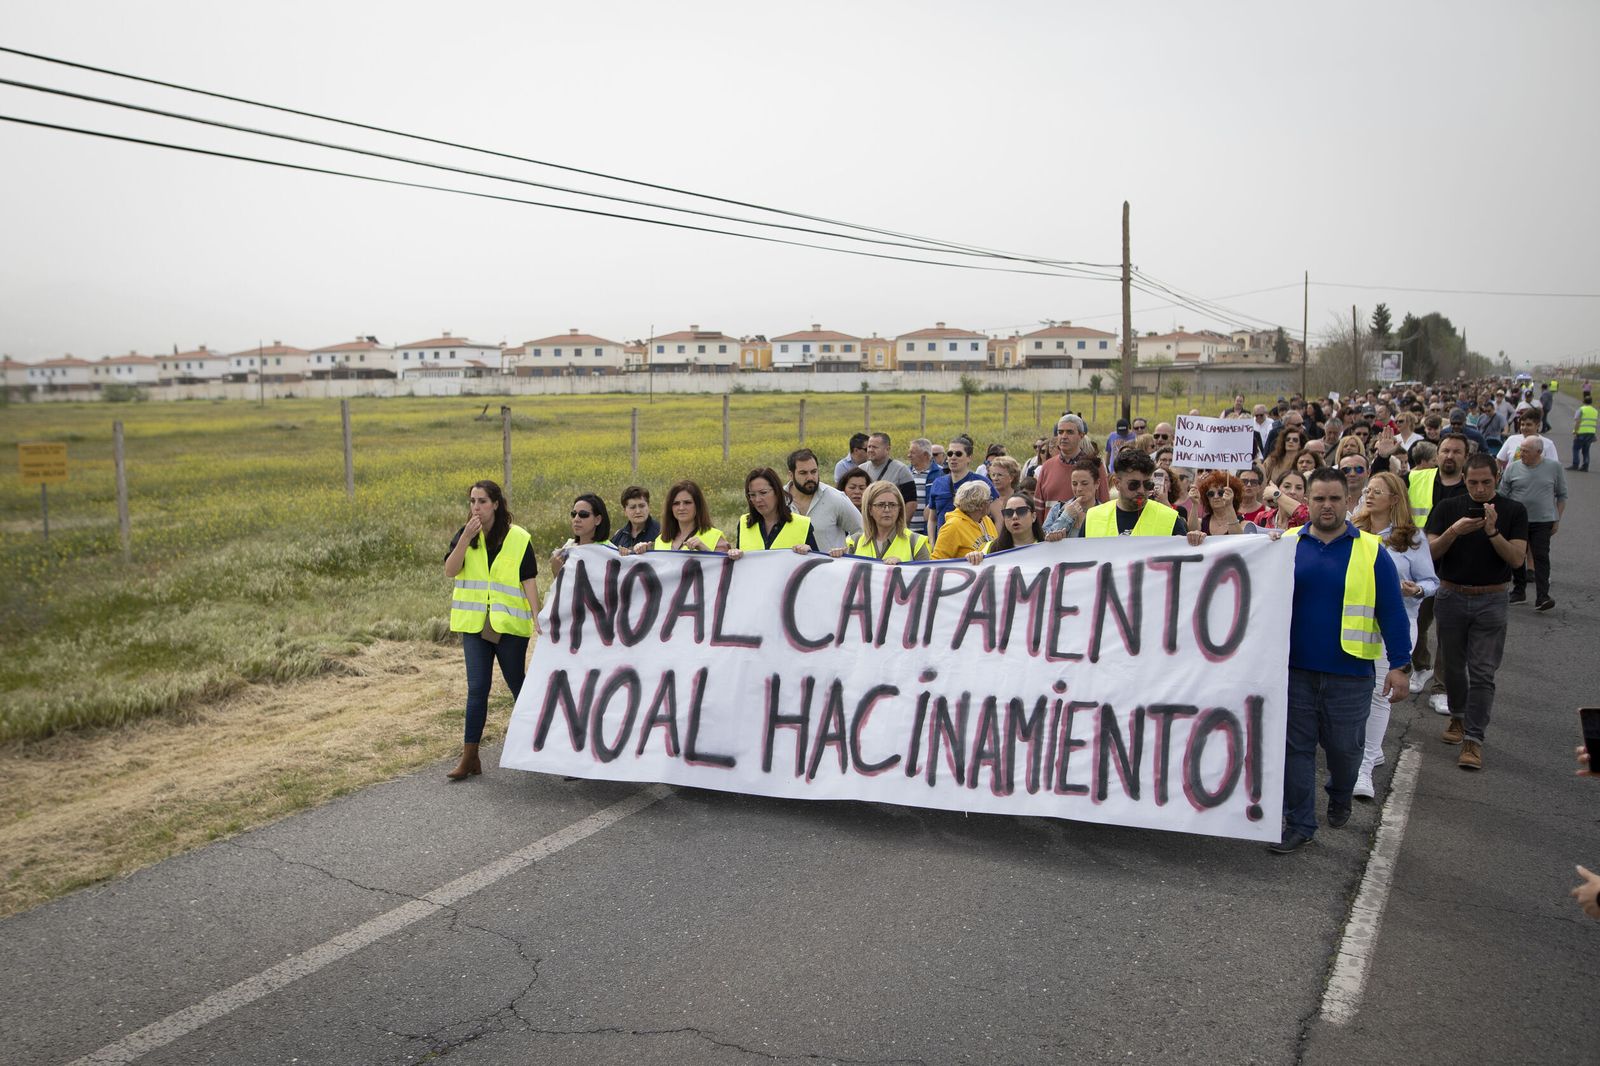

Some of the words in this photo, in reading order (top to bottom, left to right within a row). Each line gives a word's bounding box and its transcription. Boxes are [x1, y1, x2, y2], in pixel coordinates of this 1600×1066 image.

[1177, 416, 1194, 431] NO
[1195, 422, 1206, 431] AL
[1175, 435, 1192, 447] NO
[1193, 439, 1205, 448] AL
[1176, 451, 1253, 463] HACINAMIENTO
[780, 552, 1252, 663] CAMPAMENTO
